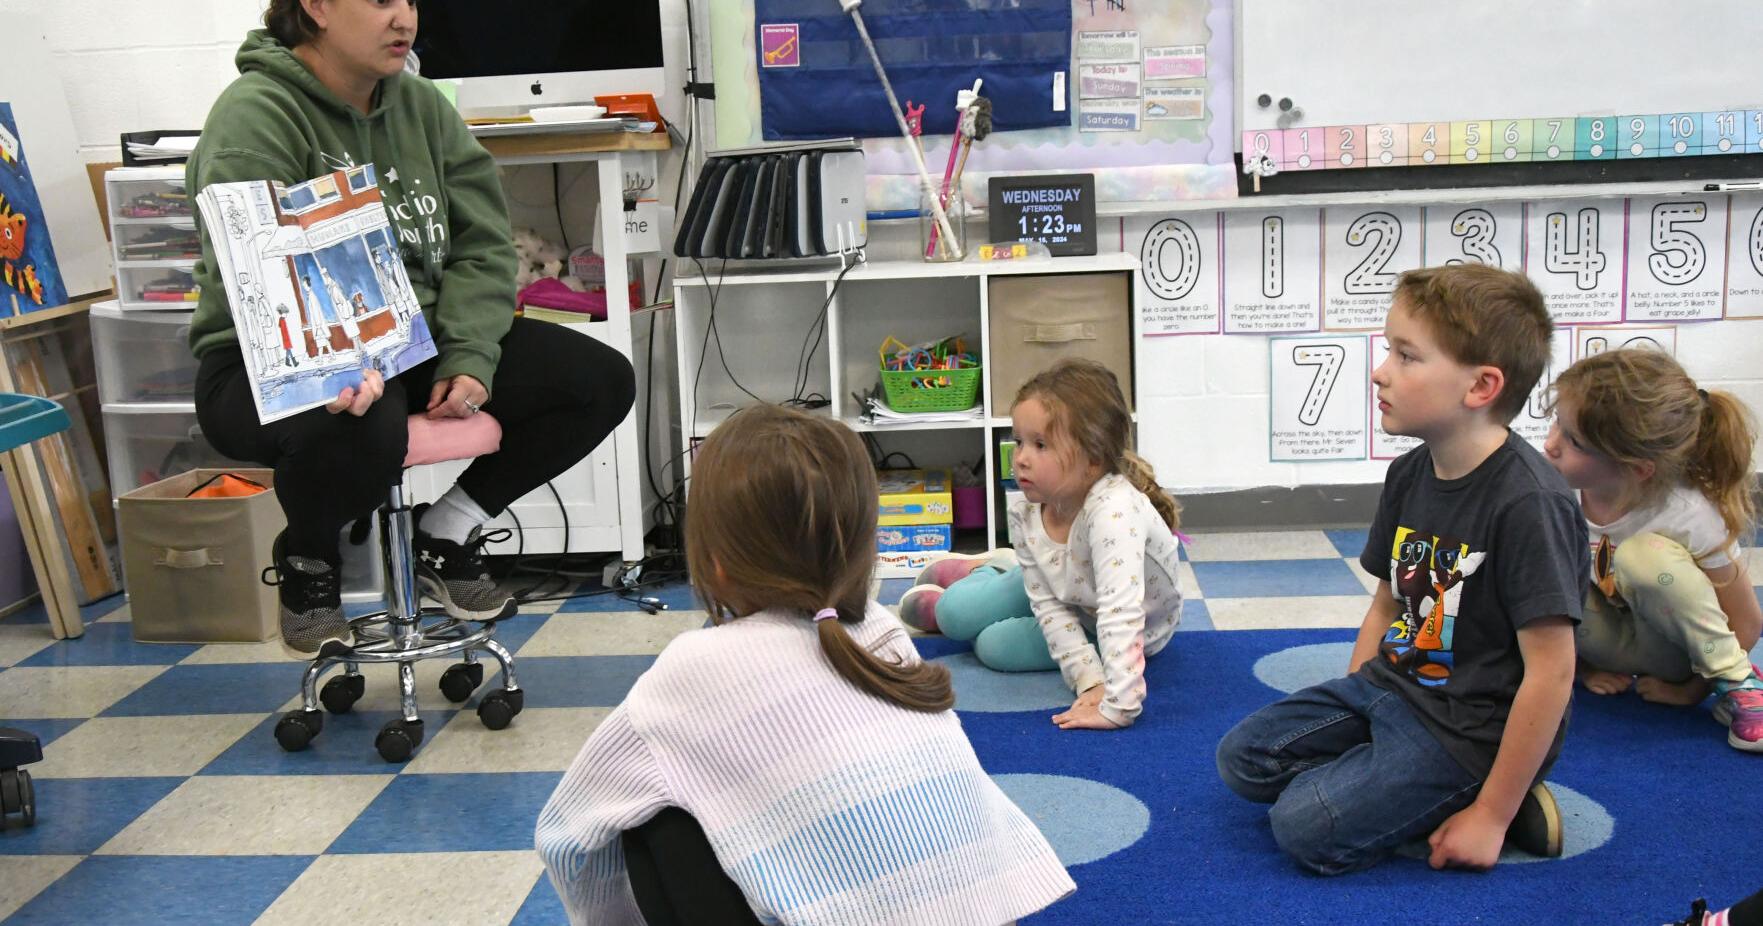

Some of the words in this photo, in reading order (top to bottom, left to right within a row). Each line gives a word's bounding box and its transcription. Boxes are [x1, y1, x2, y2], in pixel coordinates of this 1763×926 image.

[1092, 66, 1116, 74] Today
[1094, 82, 1126, 94] Sunday
[1086, 115, 1130, 126] Saturday
[1254, 132, 1270, 154] 0
[1300, 131, 1309, 152] 1
[1339, 128, 1354, 150] 2
[1379, 126, 1394, 148] 3
[1422, 125, 1437, 146] 4
[1466, 124, 1480, 146] 5
[1504, 122, 1519, 144] 6
[1547, 120, 1561, 143] 7
[1590, 119, 1605, 141] 8
[1630, 118, 1646, 140] 9
[1668, 116, 1694, 138] 10
[1716, 114, 1734, 136] 11
[1002, 188, 1081, 204] WEDNESDAY
[1022, 204, 1062, 213] AFTERNOON
[1019, 214, 1065, 235] 1:23
[1066, 224, 1081, 233] PM
[1446, 208, 1502, 266] 3
[1545, 207, 1606, 290] 4
[1648, 201, 1707, 286] 5
[1141, 218, 1201, 300] 0
[1262, 216, 1284, 298] 1
[1344, 212, 1402, 294] 2
[1293, 344, 1345, 426] 7
